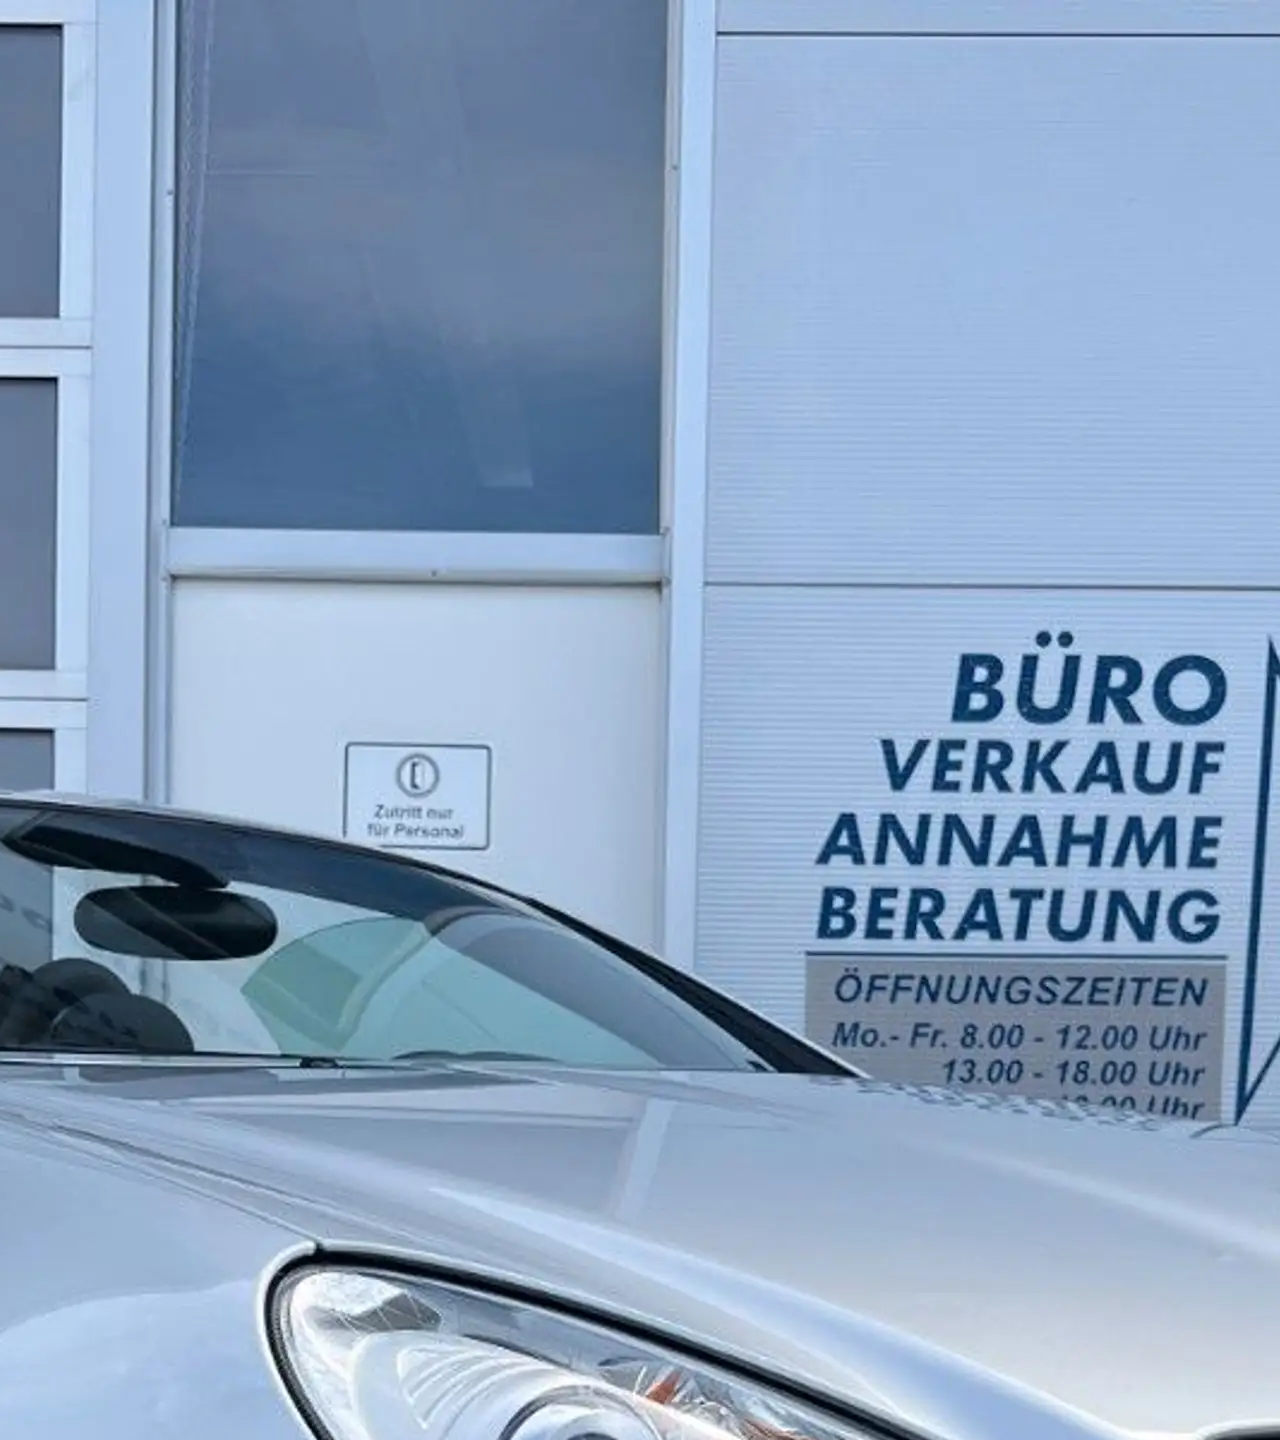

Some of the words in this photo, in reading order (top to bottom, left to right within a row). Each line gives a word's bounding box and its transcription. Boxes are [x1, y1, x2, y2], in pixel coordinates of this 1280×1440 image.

[950, 630, 1228, 726] BÜRO
[878, 738, 1226, 795] VERKAUF
[368, 823, 390, 838] für
[394, 823, 464, 838] Personal
[374, 804, 423, 820] Zutritt
[426, 808, 454, 820] nur
[815, 811, 1223, 869] ANNAHME
[815, 886, 1221, 944] BERATUNG
[833, 967, 1209, 1007] ÖFFNUNGSZEITEN
[908, 1022, 948, 1049] Fr.
[960, 1023, 1025, 1050] 8.00
[1056, 1024, 1138, 1051] 12.00
[1148, 1024, 1208, 1052] Uhr
[942, 1058, 1024, 1085] 13.00
[1056, 1060, 1137, 1086] 18.00
[1147, 1060, 1206, 1087] Uhr
